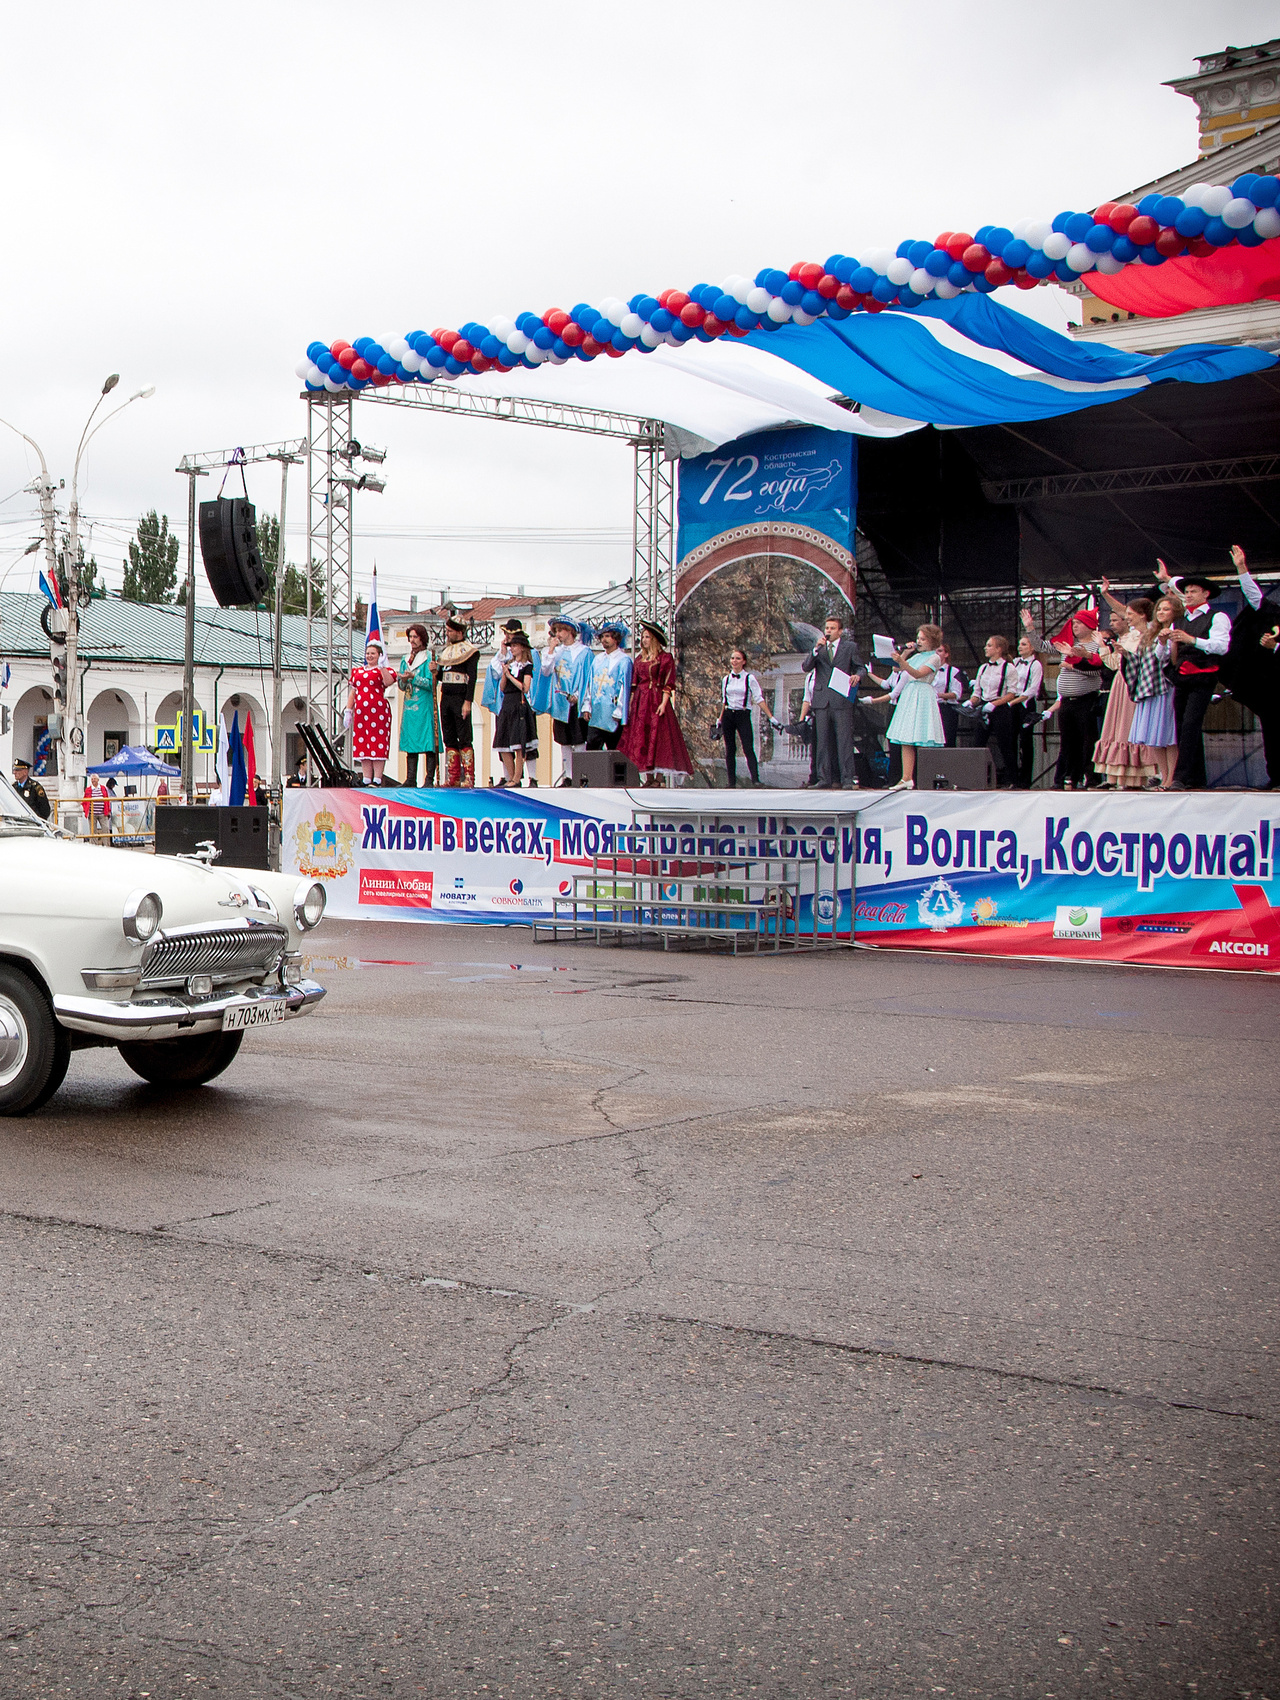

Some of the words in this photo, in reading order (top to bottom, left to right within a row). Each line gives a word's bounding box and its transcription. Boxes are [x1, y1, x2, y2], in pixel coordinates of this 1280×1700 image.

[764, 449, 817, 461] Костромская
[763, 461, 797, 470] область
[699, 455, 759, 505] 72
[759, 477, 807, 507] года
[361, 807, 433, 851] Живи
[442, 820, 456, 852] в
[465, 820, 552, 867] веках,
[562, 823, 616, 857] моя
[758, 816, 893, 878] Россия,
[906, 814, 1029, 881] Волга,
[1044, 816, 1271, 888] Кострома!
[361, 877, 395, 889] Линии
[397, 878, 432, 891] Любви
[440, 892, 477, 901] НОВАТЭК
[491, 896, 543, 907] СОВКОМБАНК
[1053, 929, 1102, 939] СБЕРБАНК
[1208, 940, 1269, 956] АКСОН
